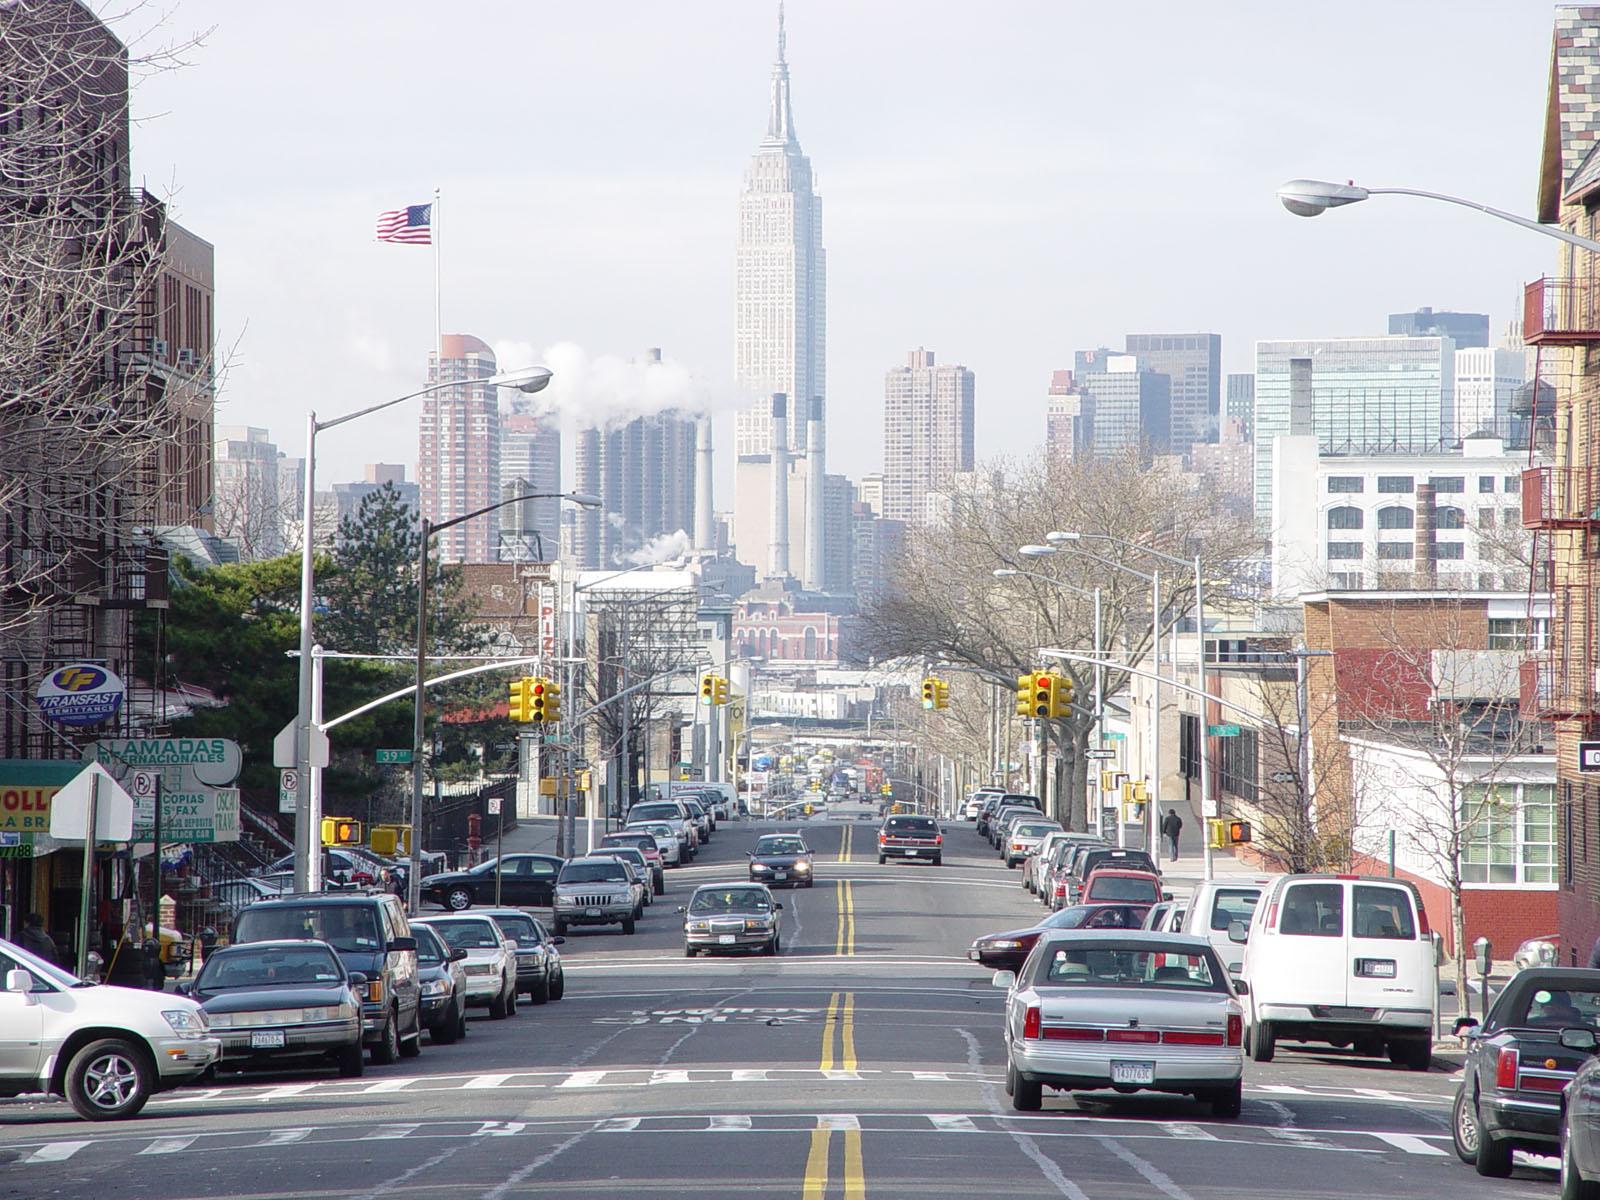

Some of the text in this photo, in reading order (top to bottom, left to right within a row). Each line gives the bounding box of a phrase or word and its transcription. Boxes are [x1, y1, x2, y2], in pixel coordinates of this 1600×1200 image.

[59, 668, 96, 691] TF
[42, 692, 119, 708] TRANSFAST
[97, 739, 225, 755] LLAMADAS
[97, 753, 225, 765] INERNACIONALES
[382, 751, 398, 761] 39
[162, 794, 205, 805] COPIAS
[176, 805, 198, 816] FAX
[23, 816, 52, 828] BR
